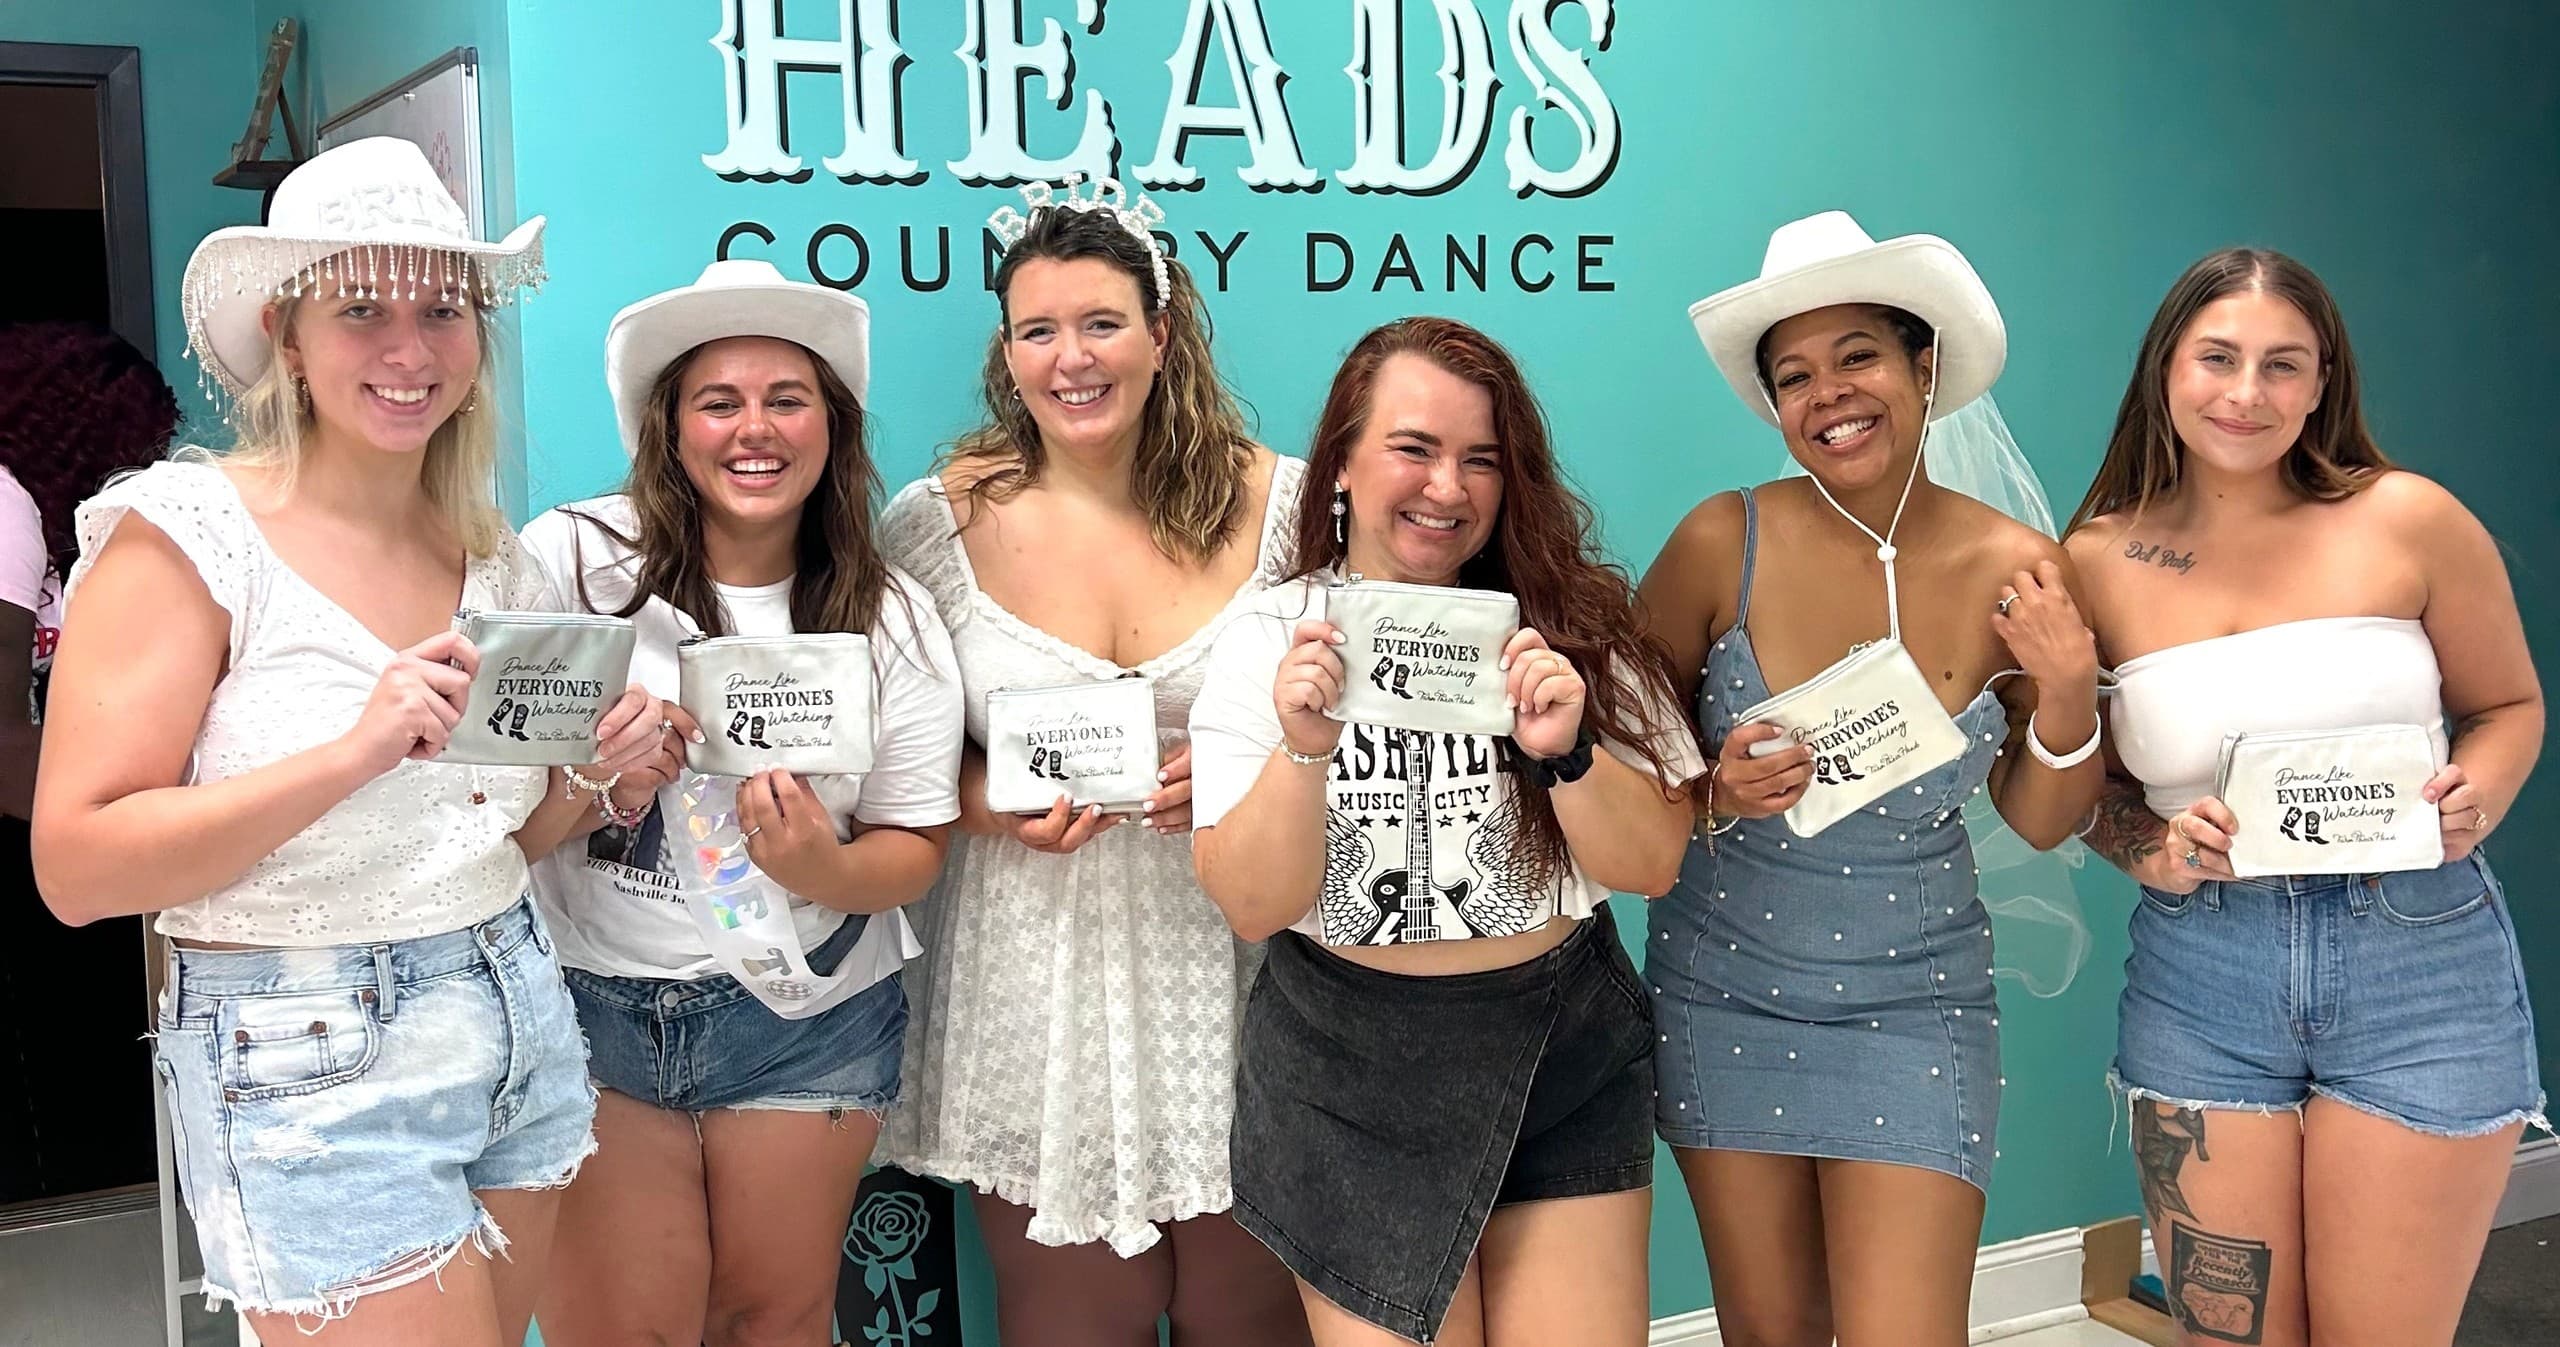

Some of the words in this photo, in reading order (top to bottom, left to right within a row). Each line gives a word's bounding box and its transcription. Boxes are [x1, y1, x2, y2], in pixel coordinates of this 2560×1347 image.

[702, 0, 1622, 198] HEADS
[1306, 232, 1617, 293] DANCE
[2159, 550, 2197, 576] Baby
[1373, 616, 1421, 634] Dance
[1420, 621, 1449, 638] Like
[1372, 637, 1480, 662] EVERYONE'S
[500, 656, 541, 676] Dance
[541, 657, 570, 676] Like
[1412, 661, 1477, 686] Watching
[495, 678, 603, 697] EVERYONE'S
[725, 673, 771, 691] Dance
[770, 672, 800, 689] Like
[726, 689, 834, 709] EVERYONE'S
[531, 700, 598, 723] Watching
[768, 711, 833, 729] Watching
[1027, 725, 1124, 746] EVERYONE'S
[1791, 720, 1832, 745] Dance
[1833, 707, 1857, 728] Like
[1808, 699, 1899, 753] VERYONE'S
[1845, 720, 1908, 759] Watching
[1065, 744, 1123, 760] Watching
[2274, 768, 2324, 786] Dance
[2323, 766, 2354, 784] Like
[1338, 792, 1405, 811] MUSIC
[1435, 784, 1491, 810] CITY
[2276, 782, 2395, 804] EVERYONE'S
[2323, 804, 2397, 824] Watching
[623, 867, 684, 890] BACHEL
[613, 880, 668, 901] Nashville
[2191, 1267, 2254, 1288] Deceased
[2192, 1256, 2250, 1279] Recently
